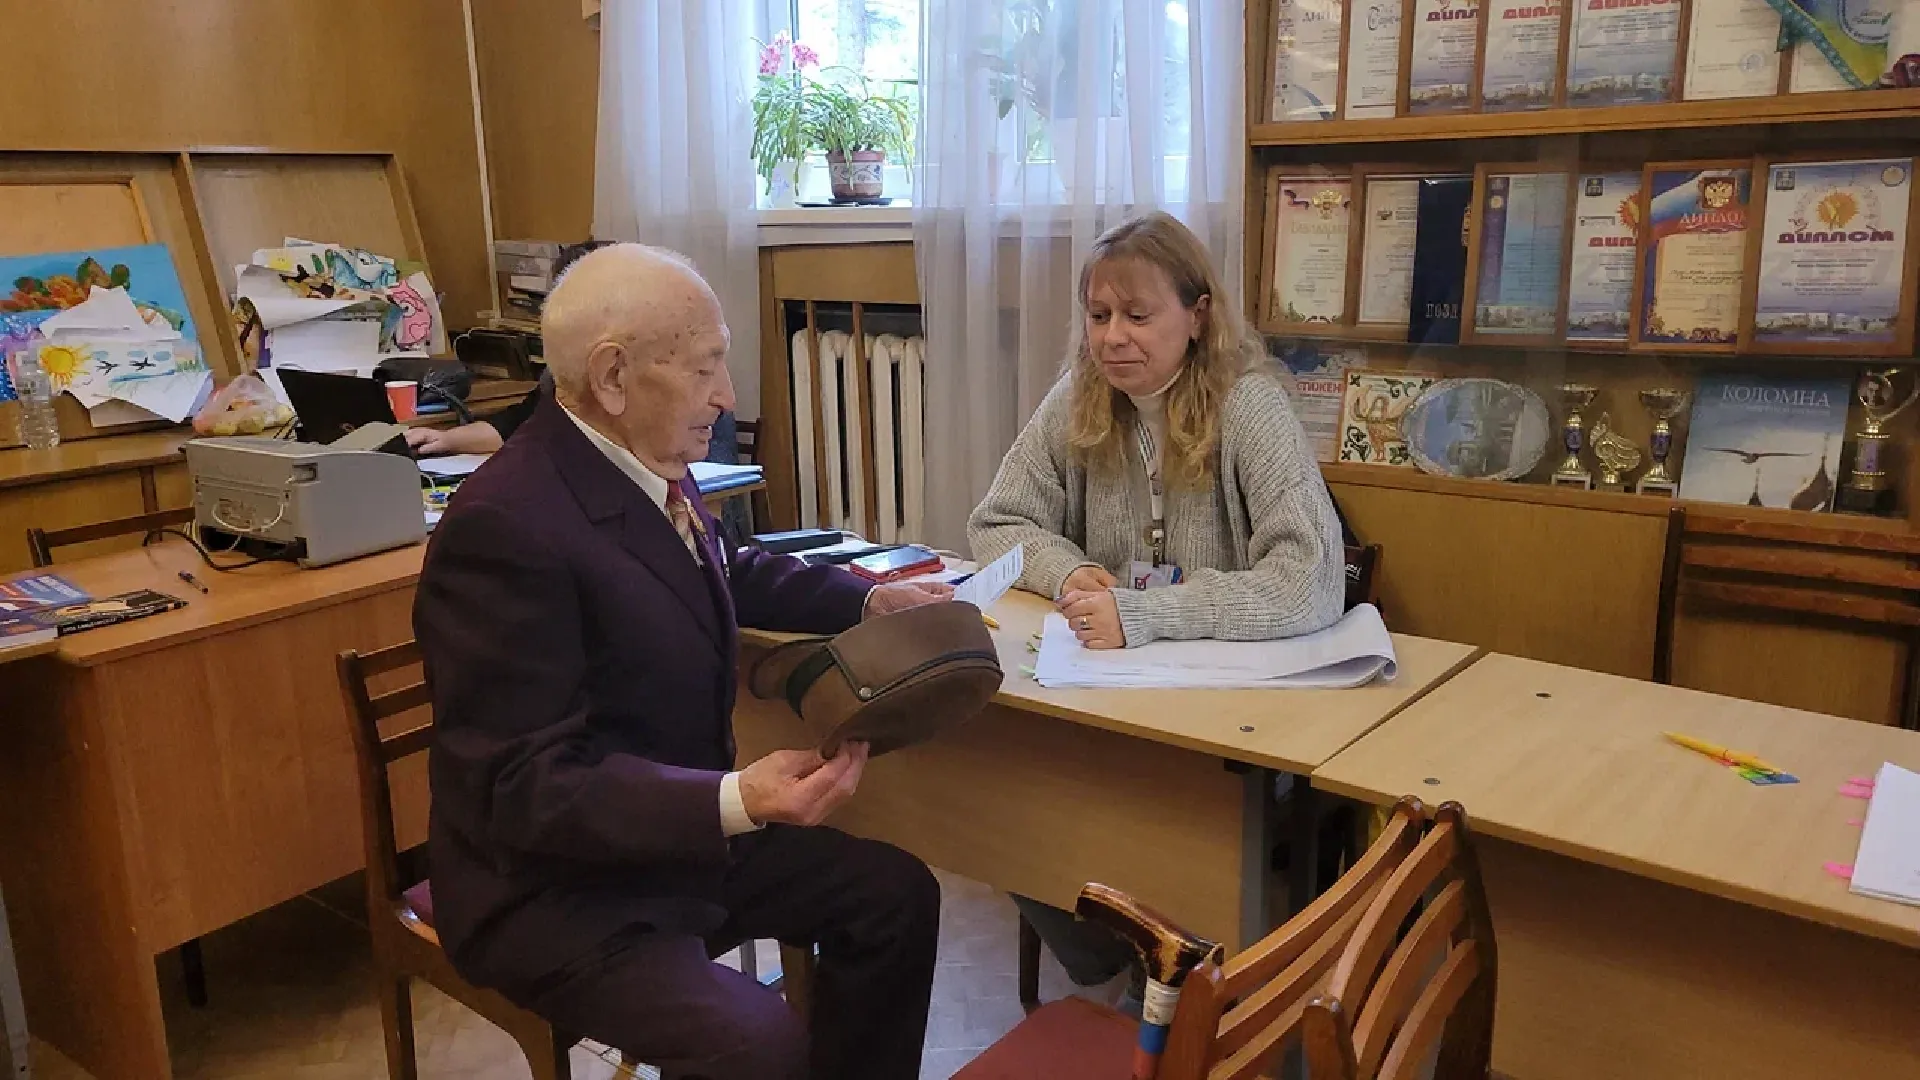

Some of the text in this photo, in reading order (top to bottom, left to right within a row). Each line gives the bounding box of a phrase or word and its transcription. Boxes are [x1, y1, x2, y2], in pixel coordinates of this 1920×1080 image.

[1680, 212, 1744, 224] ДИПЛО
[1588, 236, 1637, 248] ДИП
[1721, 384, 1831, 408] КОЛОМНА
